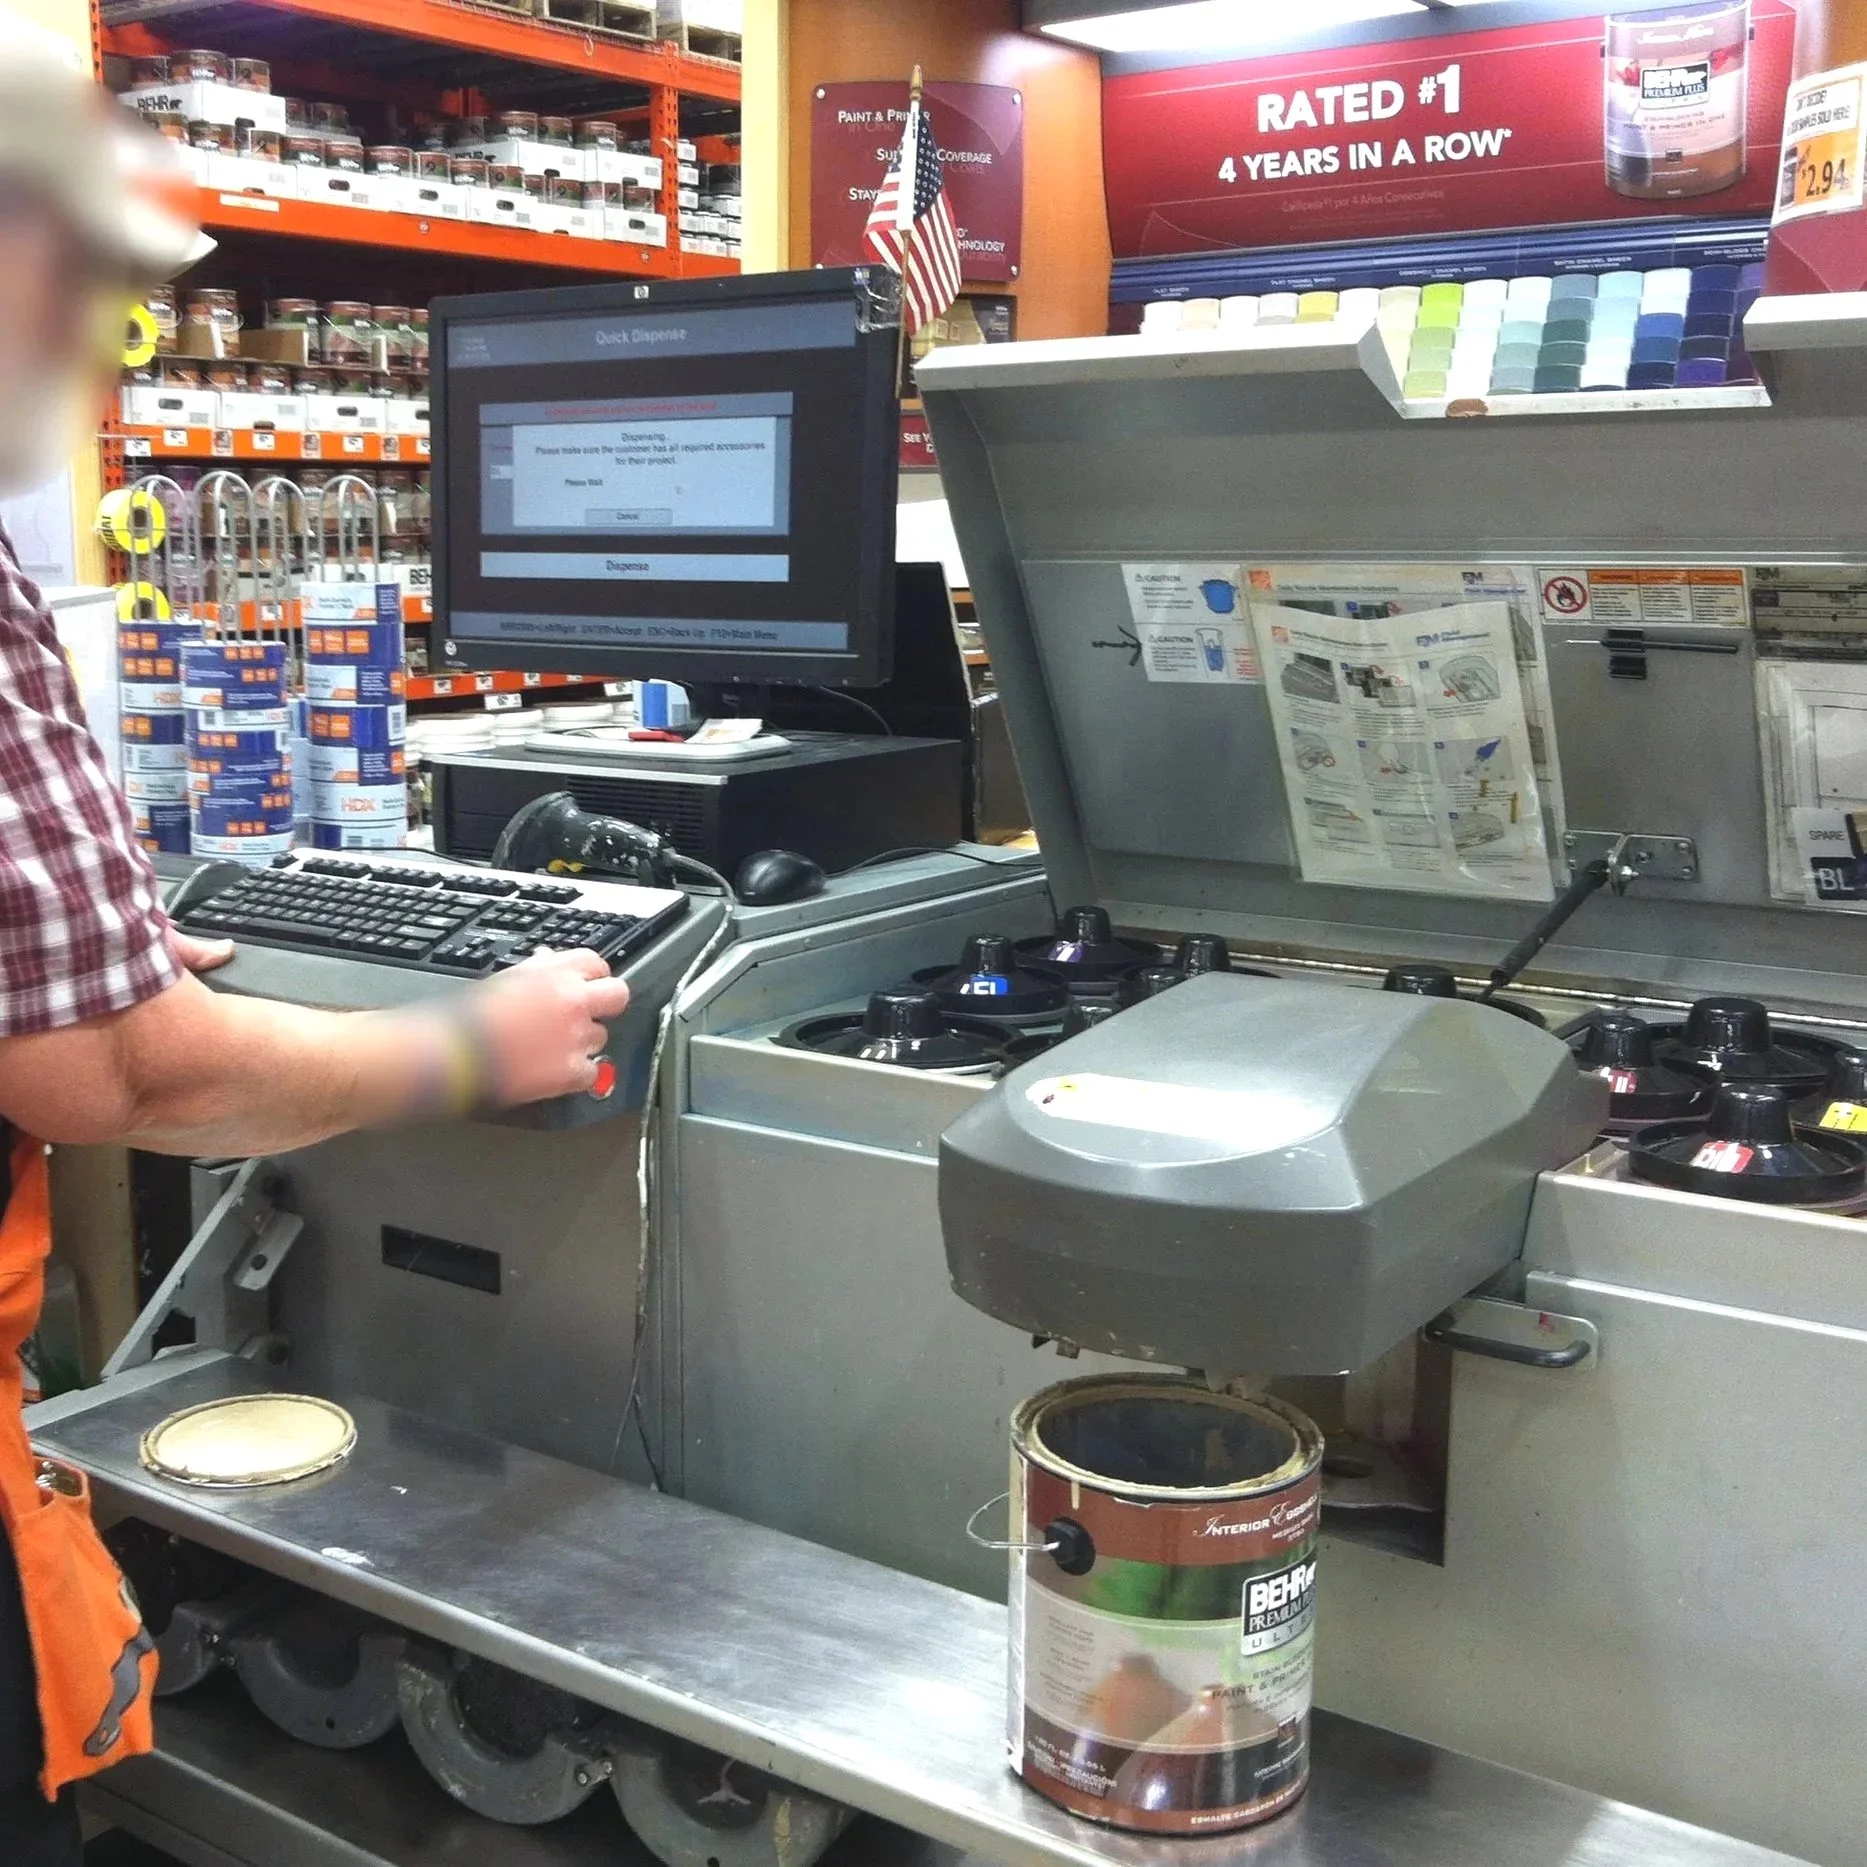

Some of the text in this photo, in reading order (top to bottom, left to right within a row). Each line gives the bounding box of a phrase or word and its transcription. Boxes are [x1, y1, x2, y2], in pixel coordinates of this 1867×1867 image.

[1256, 63, 1461, 133] RATED #1
[837, 110, 873, 124] PAINT
[874, 111, 884, 122] &
[936, 148, 993, 164] COVERAGE
[1218, 158, 1237, 183] 4
[1243, 145, 1340, 181] YEARS
[1349, 141, 1383, 170] IN
[1391, 139, 1416, 166] A
[596, 328, 687, 344] Quick Dispense
[606, 560, 650, 574] Dispense
[1808, 830, 1846, 841] SPARE
[1204, 1514, 1271, 1537] INTERIOR
[1250, 1562, 1307, 1616] BEHR
[1211, 1684, 1255, 1701] PAINT
